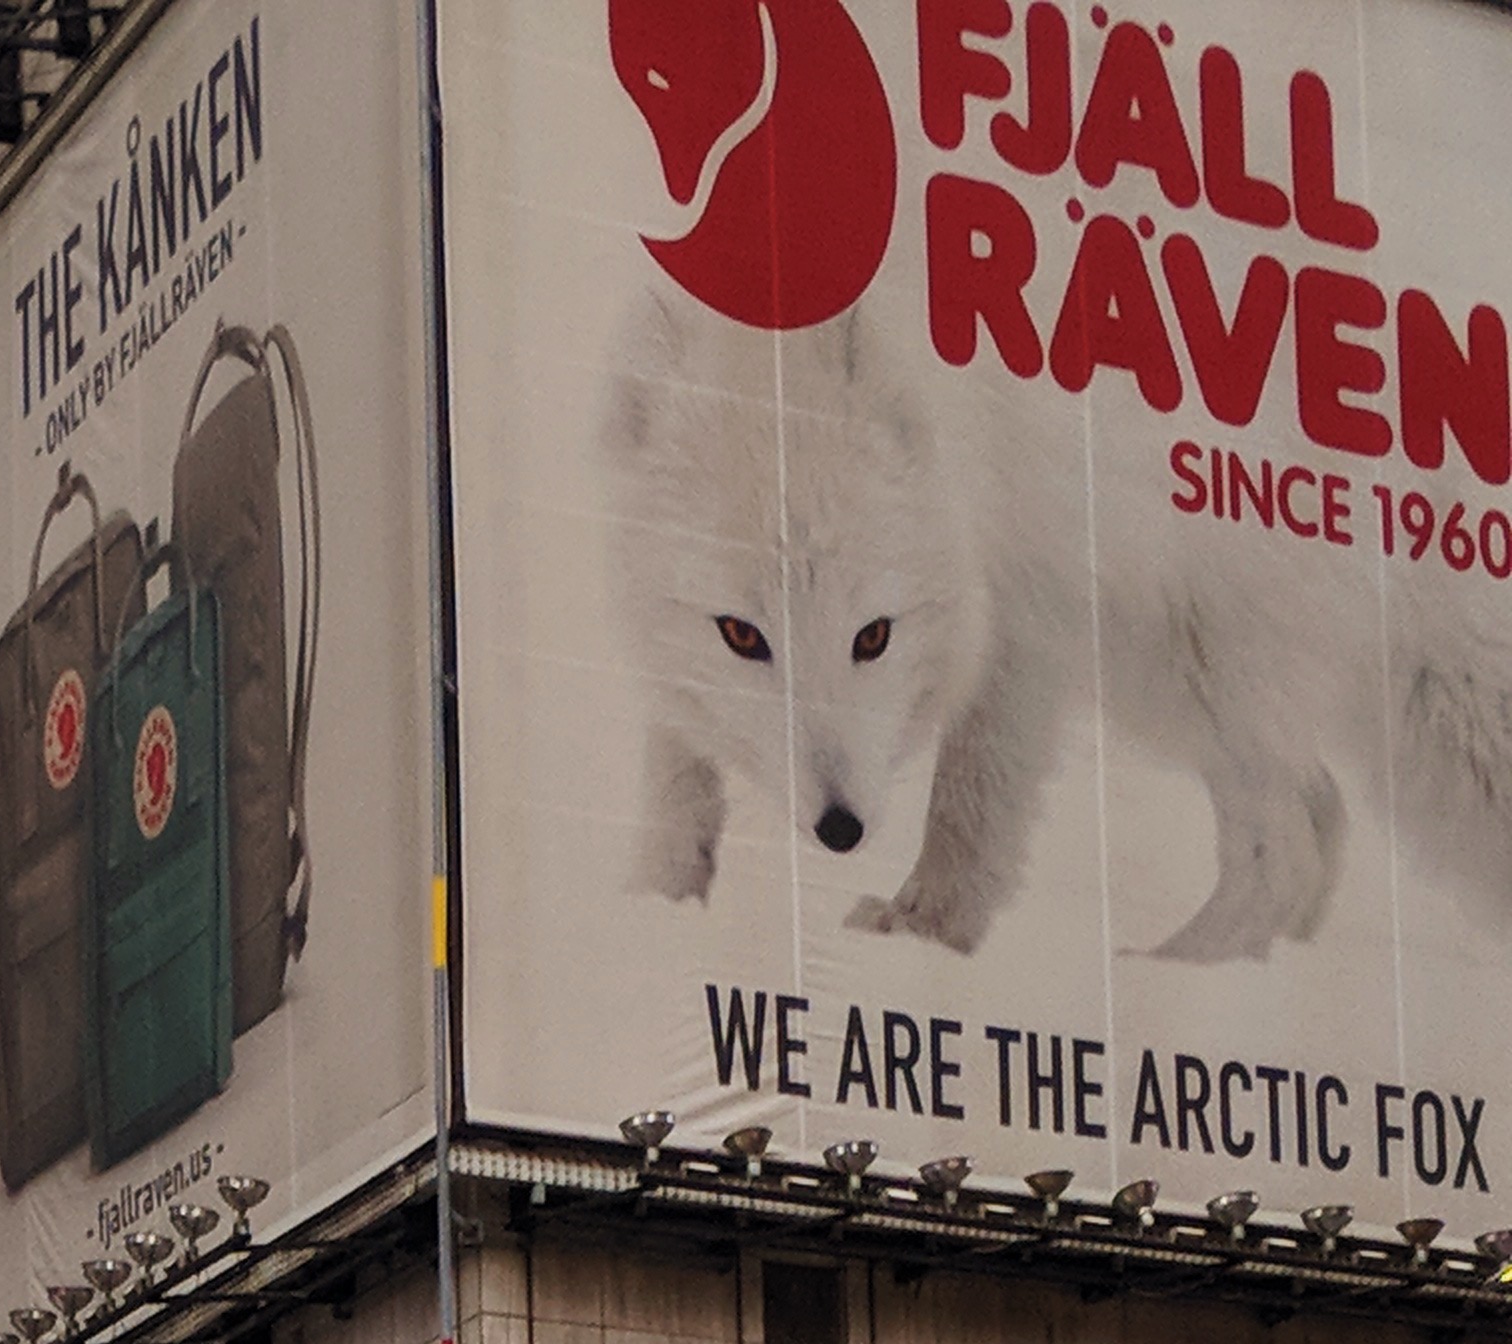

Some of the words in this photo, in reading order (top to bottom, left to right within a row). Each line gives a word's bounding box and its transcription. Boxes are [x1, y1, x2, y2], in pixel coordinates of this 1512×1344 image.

[15, 223, 84, 418] THE
[97, 16, 263, 335] KÅNKEN
[917, 0, 1379, 250] FJÄLL
[45, 383, 90, 456] ONLY
[93, 357, 116, 407] BY
[119, 220, 235, 379] FJÄLLRÄVEN
[926, 172, 1512, 485] RÄVEN
[1169, 440, 1354, 546] SINCE
[1372, 484, 1512, 580] 1960
[705, 984, 812, 1098] WE
[835, 1005, 965, 1120] ARE
[985, 1025, 1108, 1140] THE
[1130, 1048, 1351, 1172] ARCTIC
[1375, 1082, 1490, 1193] FOX
